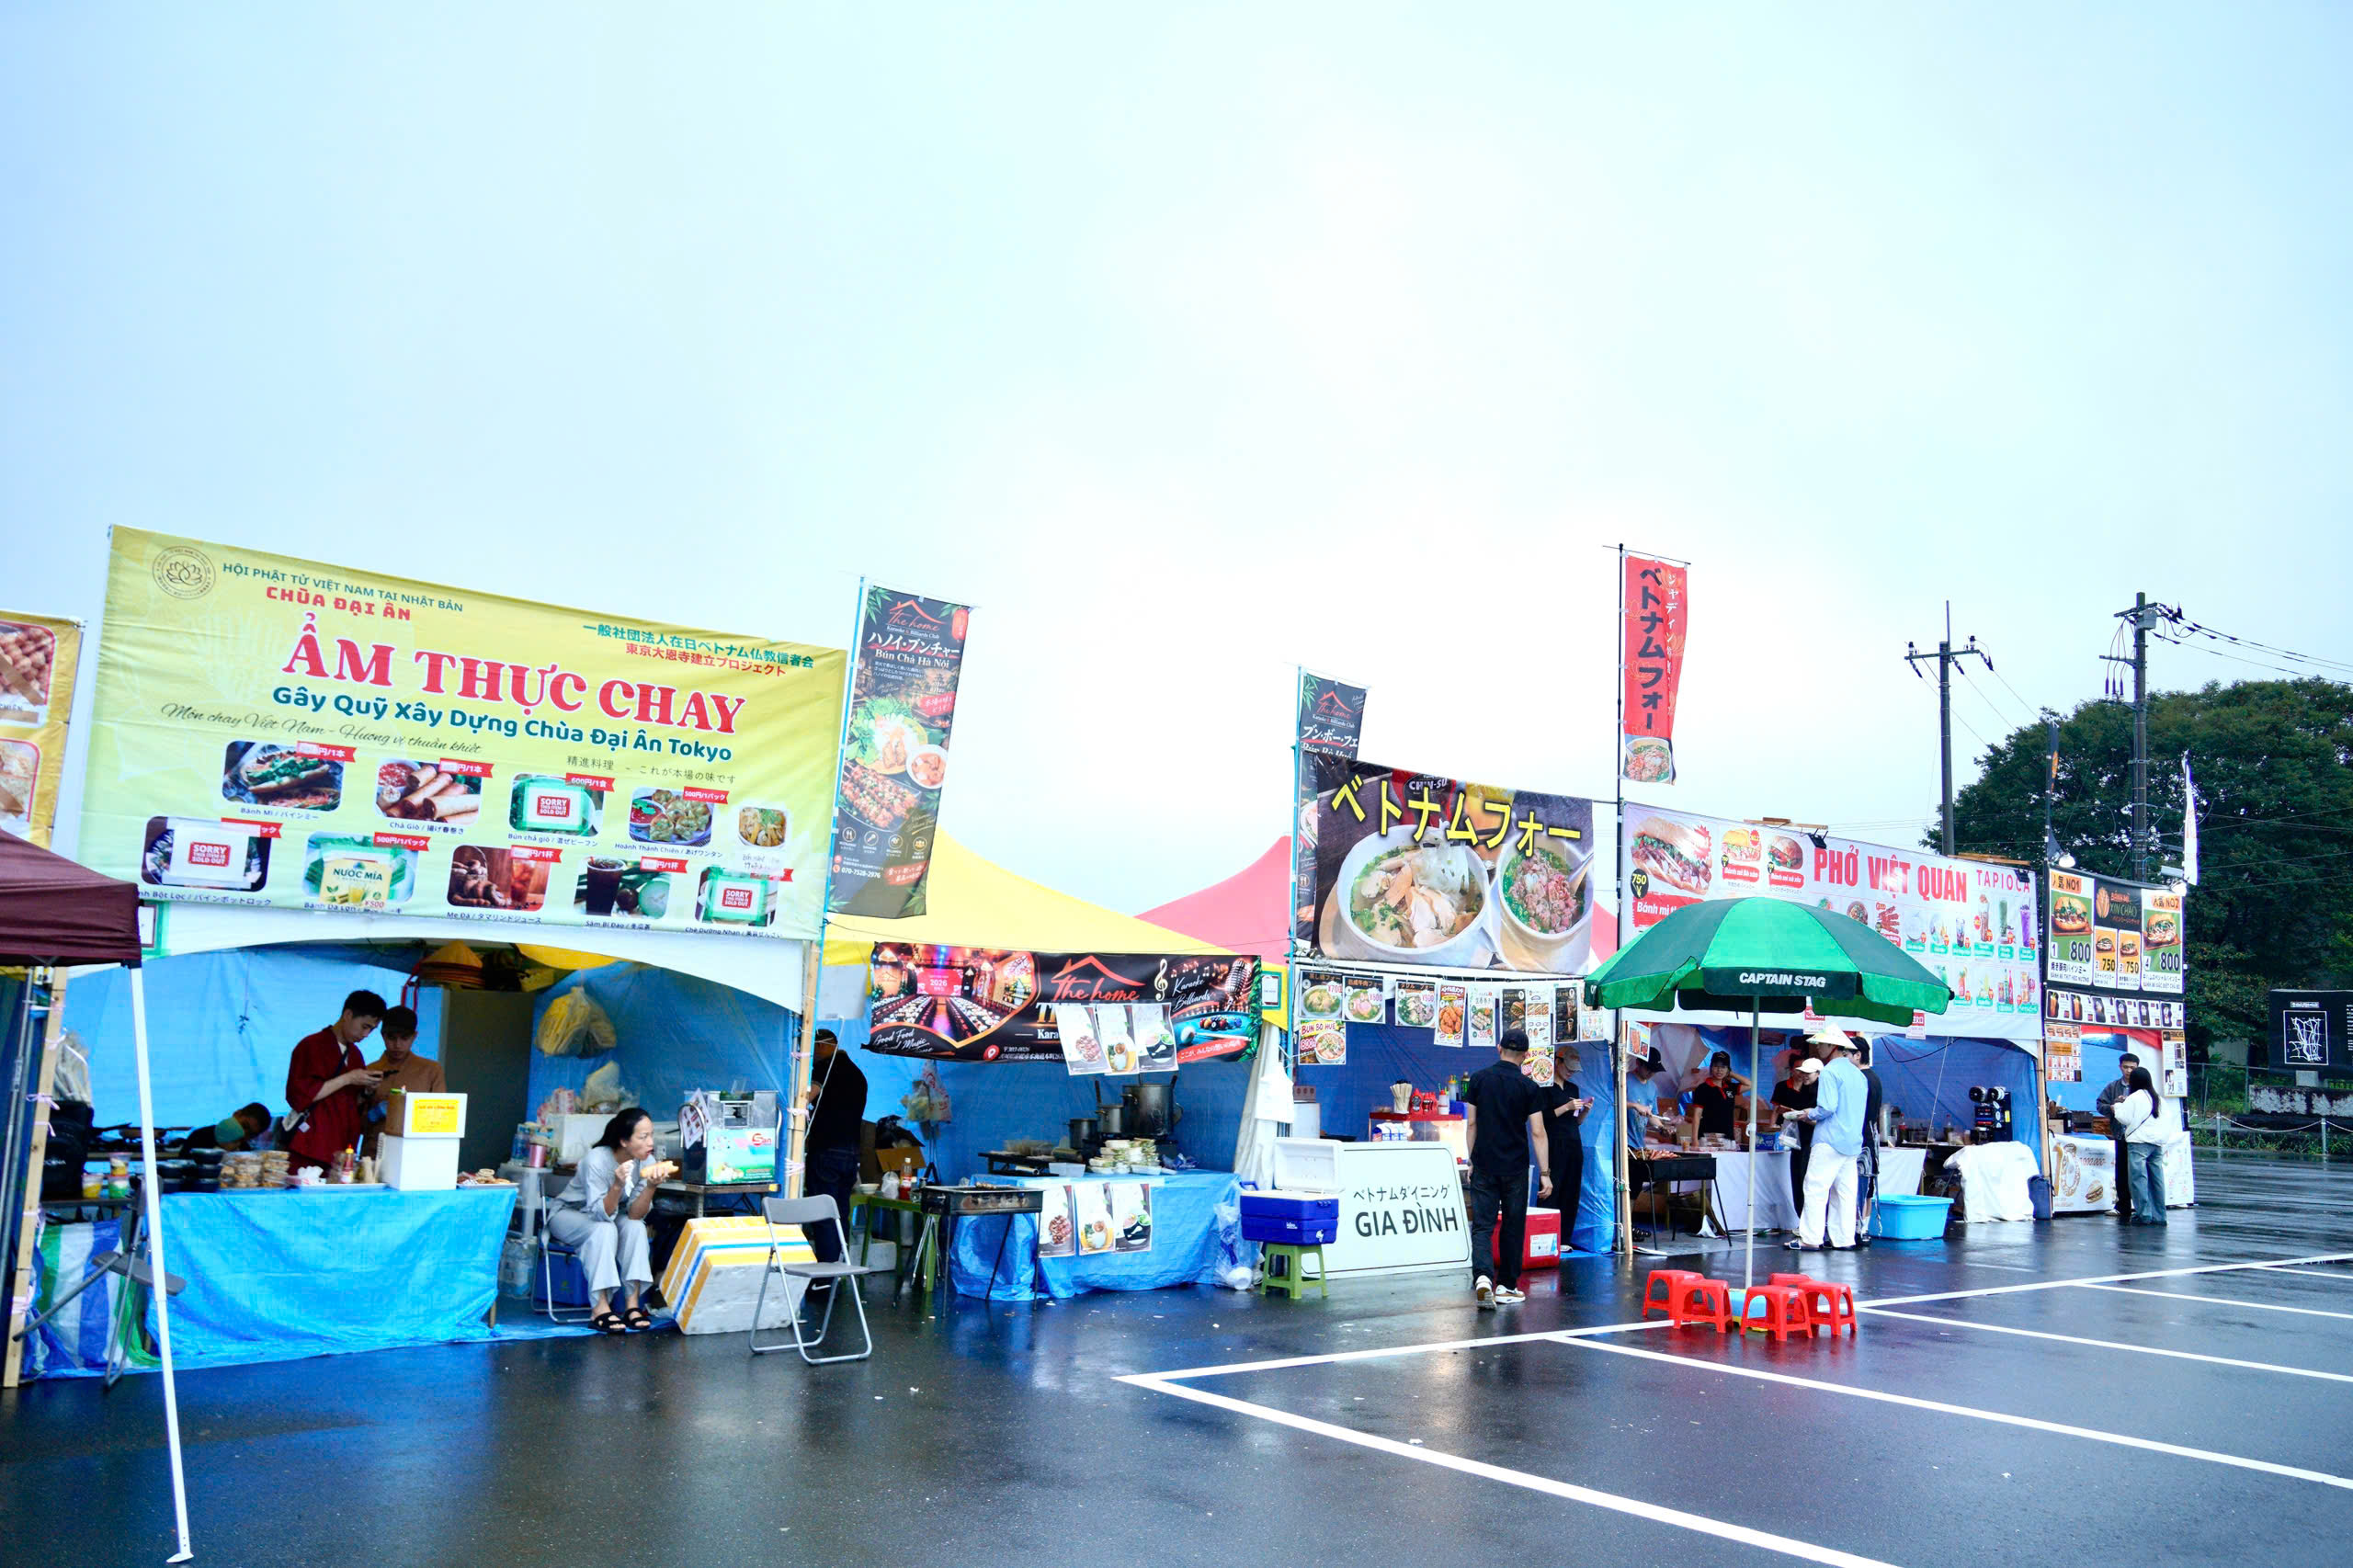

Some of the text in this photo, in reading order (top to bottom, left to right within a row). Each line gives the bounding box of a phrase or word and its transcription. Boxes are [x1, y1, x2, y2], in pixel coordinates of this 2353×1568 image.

[223, 562, 463, 613] HỘI PHẬT TỬ VIỆT NAM TẠI NHẬT BẢN
[266, 585, 411, 621] CHÙA ĐẠI ÂN
[582, 623, 815, 669] 一般社団法人在日ベトナム仏教信者会
[867, 631, 961, 657] ハノイ・ブンチャー
[1639, 567, 1666, 731] ベトナムフォー
[625, 642, 787, 677] 東京大恩寺建立プロジェクト
[874, 648, 950, 670] Bún Chả Hà Nội
[281, 611, 746, 734] ẨM THỰC CHAY
[272, 687, 732, 763] Gây Quỹ Xây Dựng Chùa Đại Ân Tokyo
[281, 719, 324, 735] Nam
[566, 755, 736, 784] 精進料理 これが本場の味です
[540, 797, 568, 808] SORRY
[1331, 774, 1582, 858] ベトナムフォー
[192, 844, 228, 856] SORRY
[1631, 873, 1647, 885] 750
[1813, 844, 1967, 903] PHỞ VIỆT QUÁN
[725, 889, 750, 898] SORRY
[1636, 901, 1659, 915] Bánh
[2070, 940, 2091, 963] 800
[2160, 951, 2180, 971] 800
[2102, 958, 2116, 971] 750
[2126, 960, 2140, 974] 750
[929, 978, 948, 988] 2026
[1090, 977, 1141, 1002] home
[1172, 974, 1205, 997] Karaoke
[1739, 971, 1826, 989] CAPTAIN STAG
[895, 1028, 915, 1043] Food
[1037, 1028, 1060, 1040] Kara
[1301, 1025, 1314, 1036] BUN
[1324, 1022, 1336, 1030] HUE
[1353, 1183, 1451, 1202] ベトナムダイニング
[1355, 1201, 1460, 1239] GIA ĐÌNH
